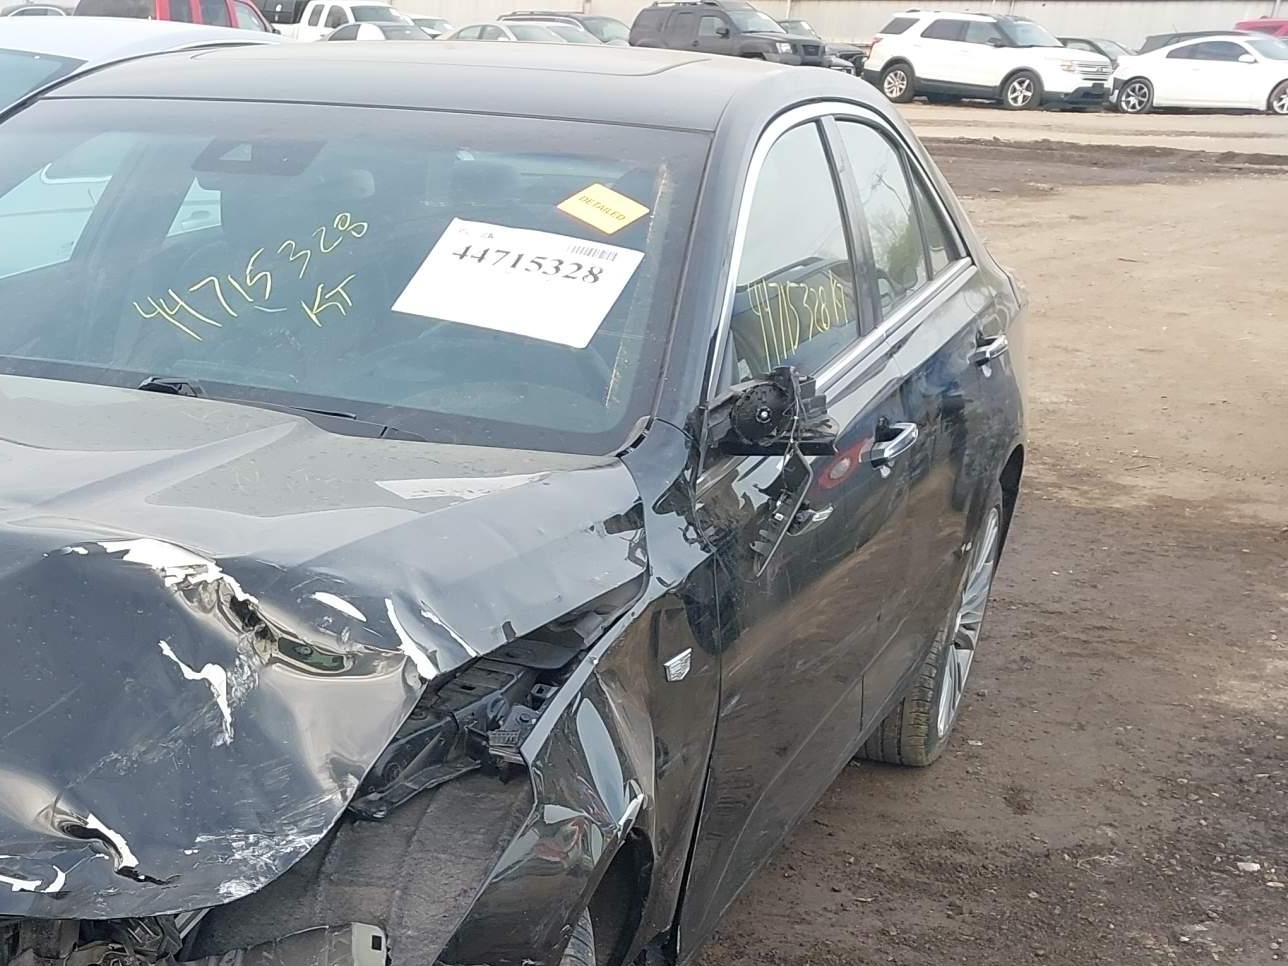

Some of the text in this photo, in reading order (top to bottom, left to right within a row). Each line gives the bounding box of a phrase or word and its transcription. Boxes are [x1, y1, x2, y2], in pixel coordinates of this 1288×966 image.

[578, 195, 626, 221] DETAILED
[132, 211, 369, 342] 44715328
[451, 244, 604, 285] 44715328
[300, 273, 357, 328] KT
